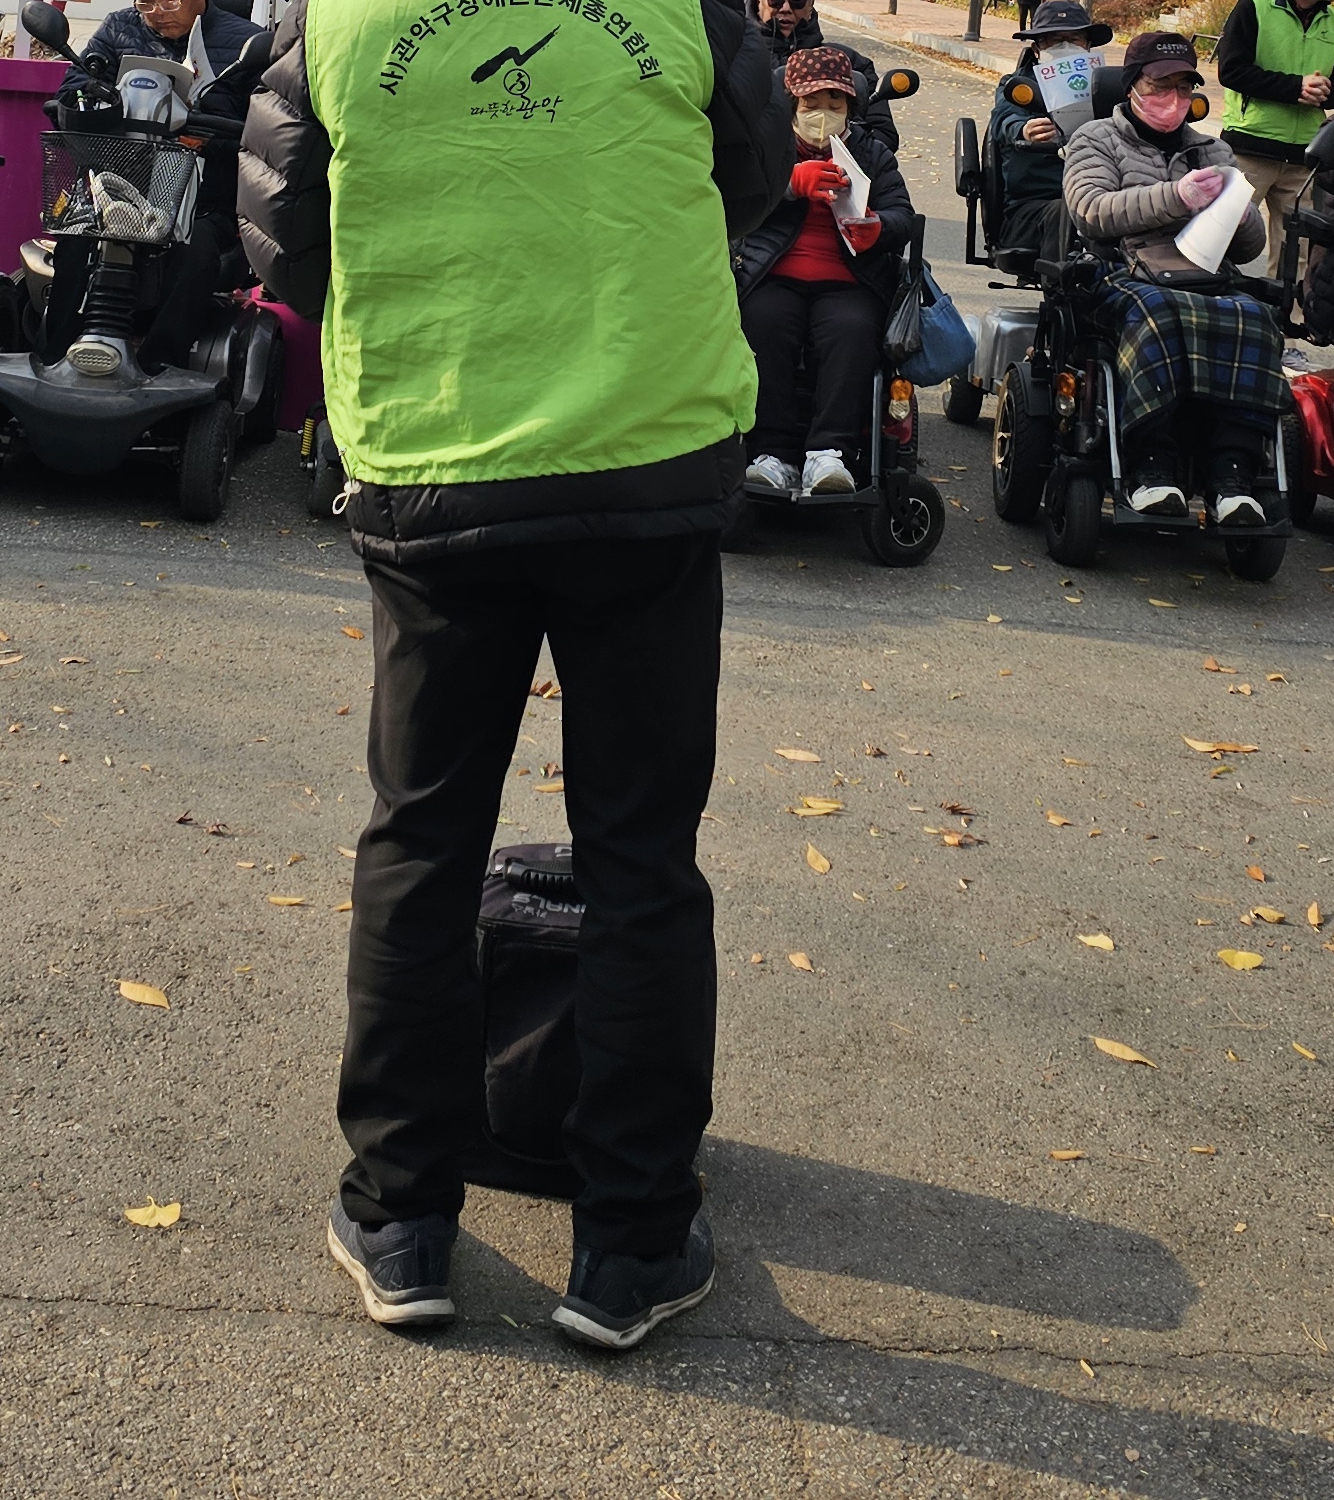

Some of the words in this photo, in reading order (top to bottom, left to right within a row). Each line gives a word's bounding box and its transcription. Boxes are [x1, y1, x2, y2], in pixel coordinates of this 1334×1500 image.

[1041, 56, 1101, 80] 안전운전
[470, 100, 515, 119] 따뜻한
[516, 94, 564, 123] 관악
